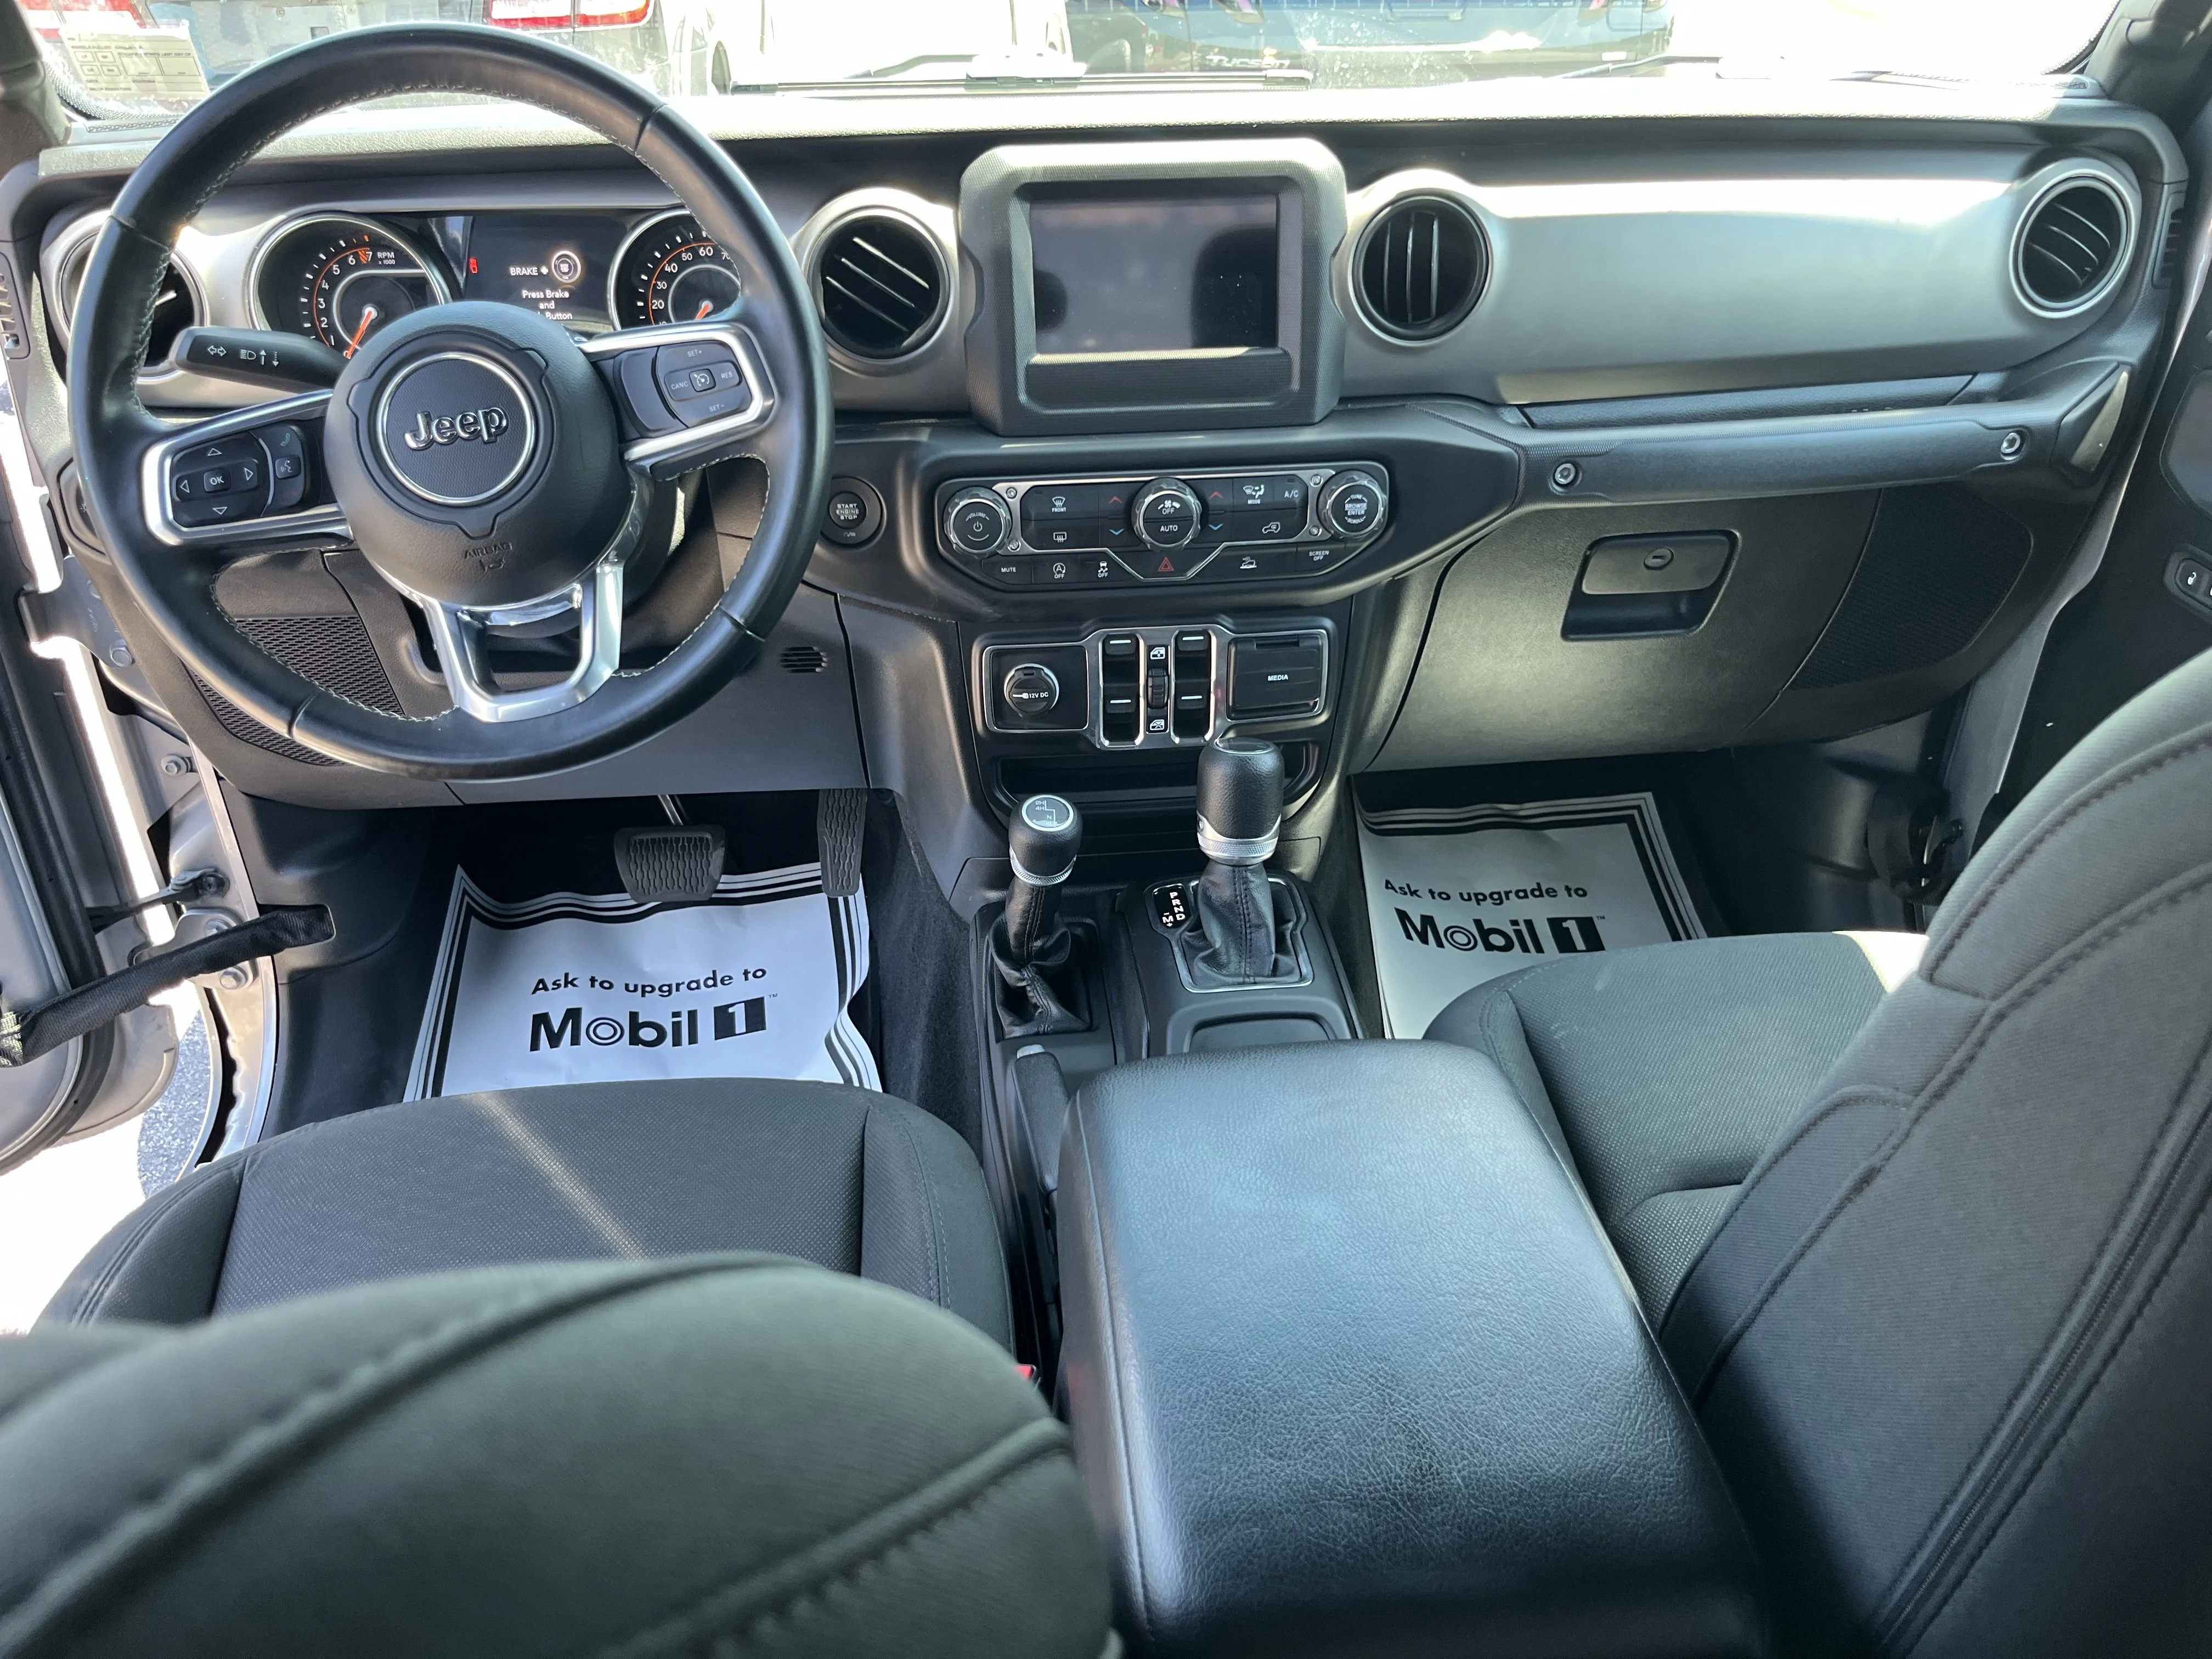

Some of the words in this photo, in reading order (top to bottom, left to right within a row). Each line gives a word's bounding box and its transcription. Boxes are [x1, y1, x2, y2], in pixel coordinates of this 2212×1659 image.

[1205, 54, 1290, 69] Tucson
[365, 251, 373, 262] 7
[699, 247, 713, 256] 60
[721, 252, 731, 260] 70
[348, 255, 356, 265] 6
[681, 253, 692, 261] 50
[333, 265, 340, 275] 5
[510, 267, 539, 275] BRAKE
[664, 263, 678, 273] 40
[321, 280, 329, 290] 4
[522, 290, 544, 299] Press
[546, 290, 569, 298] Brake
[318, 298, 325, 308] 3
[539, 300, 555, 309] and
[652, 300, 664, 309] 20
[546, 312, 573, 320] Button
[321, 317, 328, 328] 2
[330, 335, 335, 346] 1
[721, 371, 733, 380] RES
[671, 381, 689, 391] CANC
[404, 407, 509, 450] Jeep
[210, 475, 224, 486] OK
[1284, 489, 1299, 498] A/C
[1384, 879, 1423, 899] Ask
[1428, 888, 1451, 901] to
[1459, 882, 1558, 906] upgrade
[1564, 884, 1588, 898] to
[1162, 915, 1173, 923] M
[1393, 907, 1545, 954] Mobil
[531, 972, 580, 995] Ask
[589, 975, 614, 990] to
[624, 969, 733, 997] upgrade
[742, 968, 767, 981] to
[529, 1007, 698, 1052] Mobil
